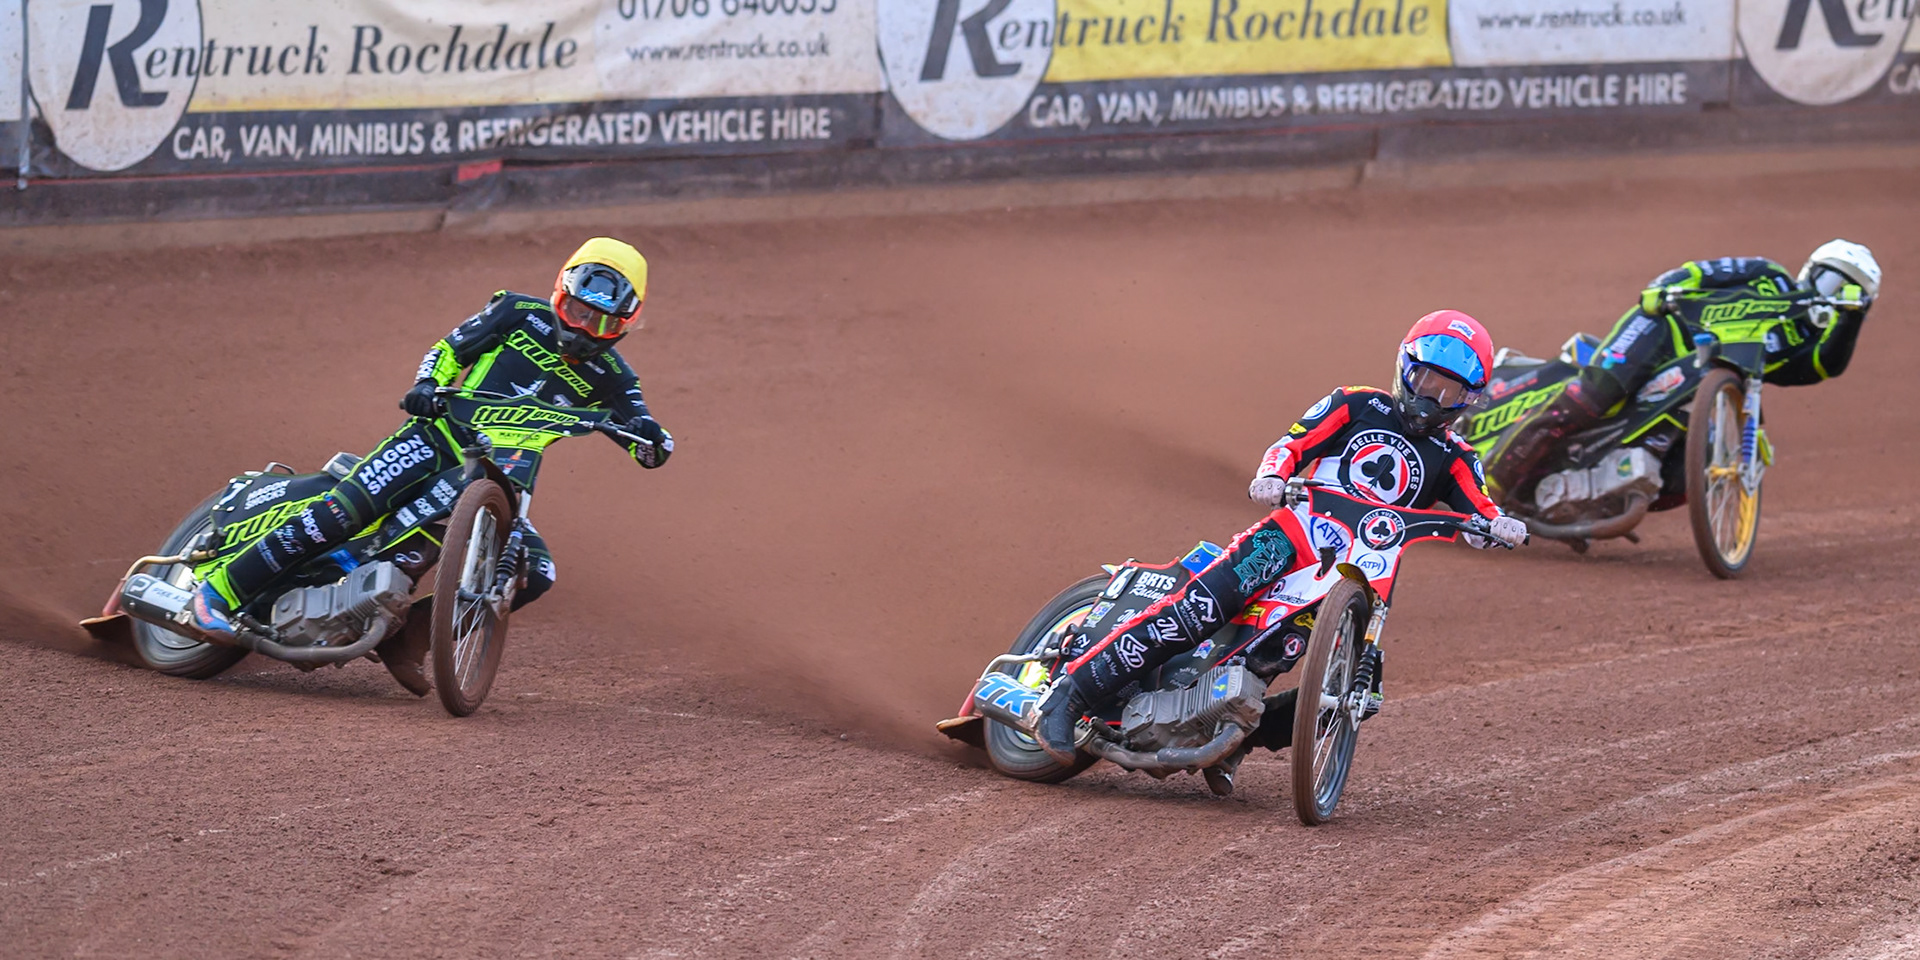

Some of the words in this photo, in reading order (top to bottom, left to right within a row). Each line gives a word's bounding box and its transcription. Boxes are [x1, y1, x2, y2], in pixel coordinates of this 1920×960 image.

[1206, 0, 1429, 43] Rochdale
[346, 20, 579, 75] Rochdale
[625, 32, 830, 61] www.rentruck.co.uk
[1169, 84, 1287, 121] MINIBUS
[1508, 74, 1621, 107] VEHICLE
[1625, 72, 1688, 105] HIRE
[173, 126, 232, 163] CAR,
[239, 124, 304, 161] VAN,
[309, 122, 425, 157] MINIBUS
[430, 121, 452, 154] &
[658, 108, 765, 144] VEHICLE
[771, 107, 831, 141] HIRE
[358, 434, 425, 484] HAGON
[367, 446, 435, 495] SHOCKS
[1350, 434, 1385, 452] BELLE
[1390, 437, 1412, 457] VUE
[1408, 460, 1420, 490] ACES
[1316, 521, 1347, 554] ATPI
[1136, 571, 1176, 591] BRTS
[1360, 560, 1382, 571] ATPI
[975, 675, 1040, 718] TK
